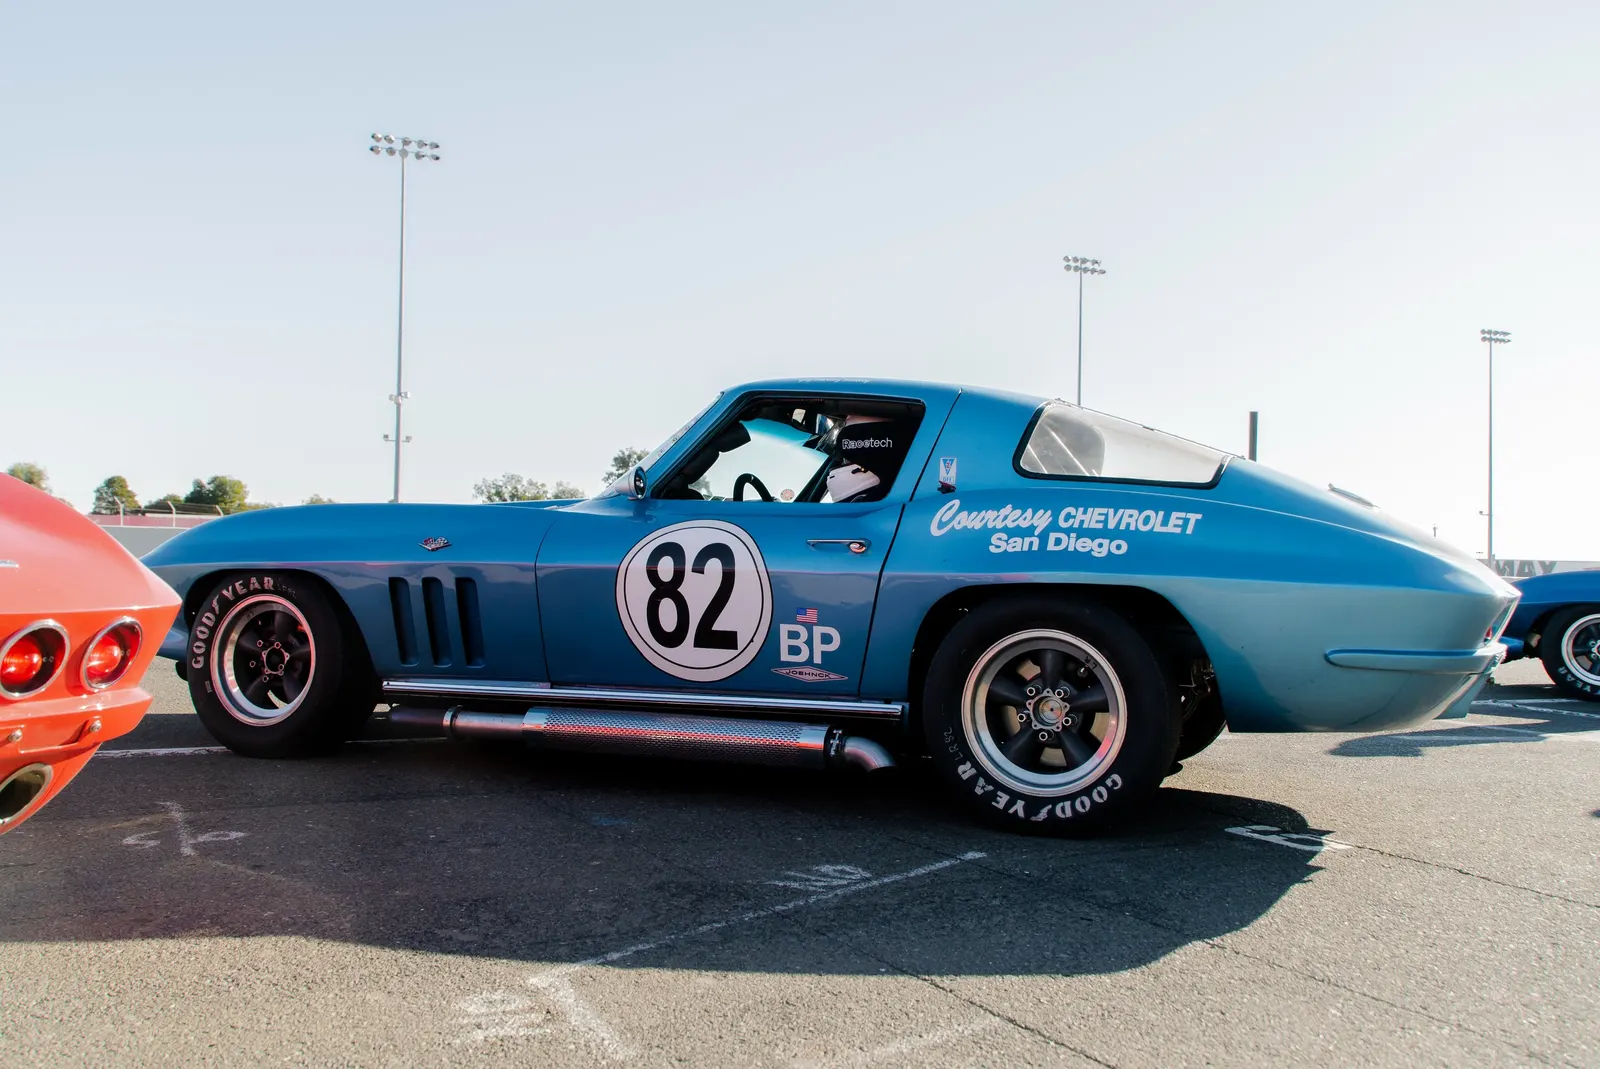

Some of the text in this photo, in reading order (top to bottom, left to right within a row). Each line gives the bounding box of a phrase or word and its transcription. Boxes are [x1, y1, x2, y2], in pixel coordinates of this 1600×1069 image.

[841, 437, 893, 450] Racetech
[930, 499, 1203, 537] Courtesy CHEVROLET
[988, 532, 1128, 558] San Diego
[645, 541, 739, 651] 82
[191, 576, 275, 669] GOODYEAR
[779, 623, 841, 664] BP
[957, 760, 1124, 822] GOODYEAR
